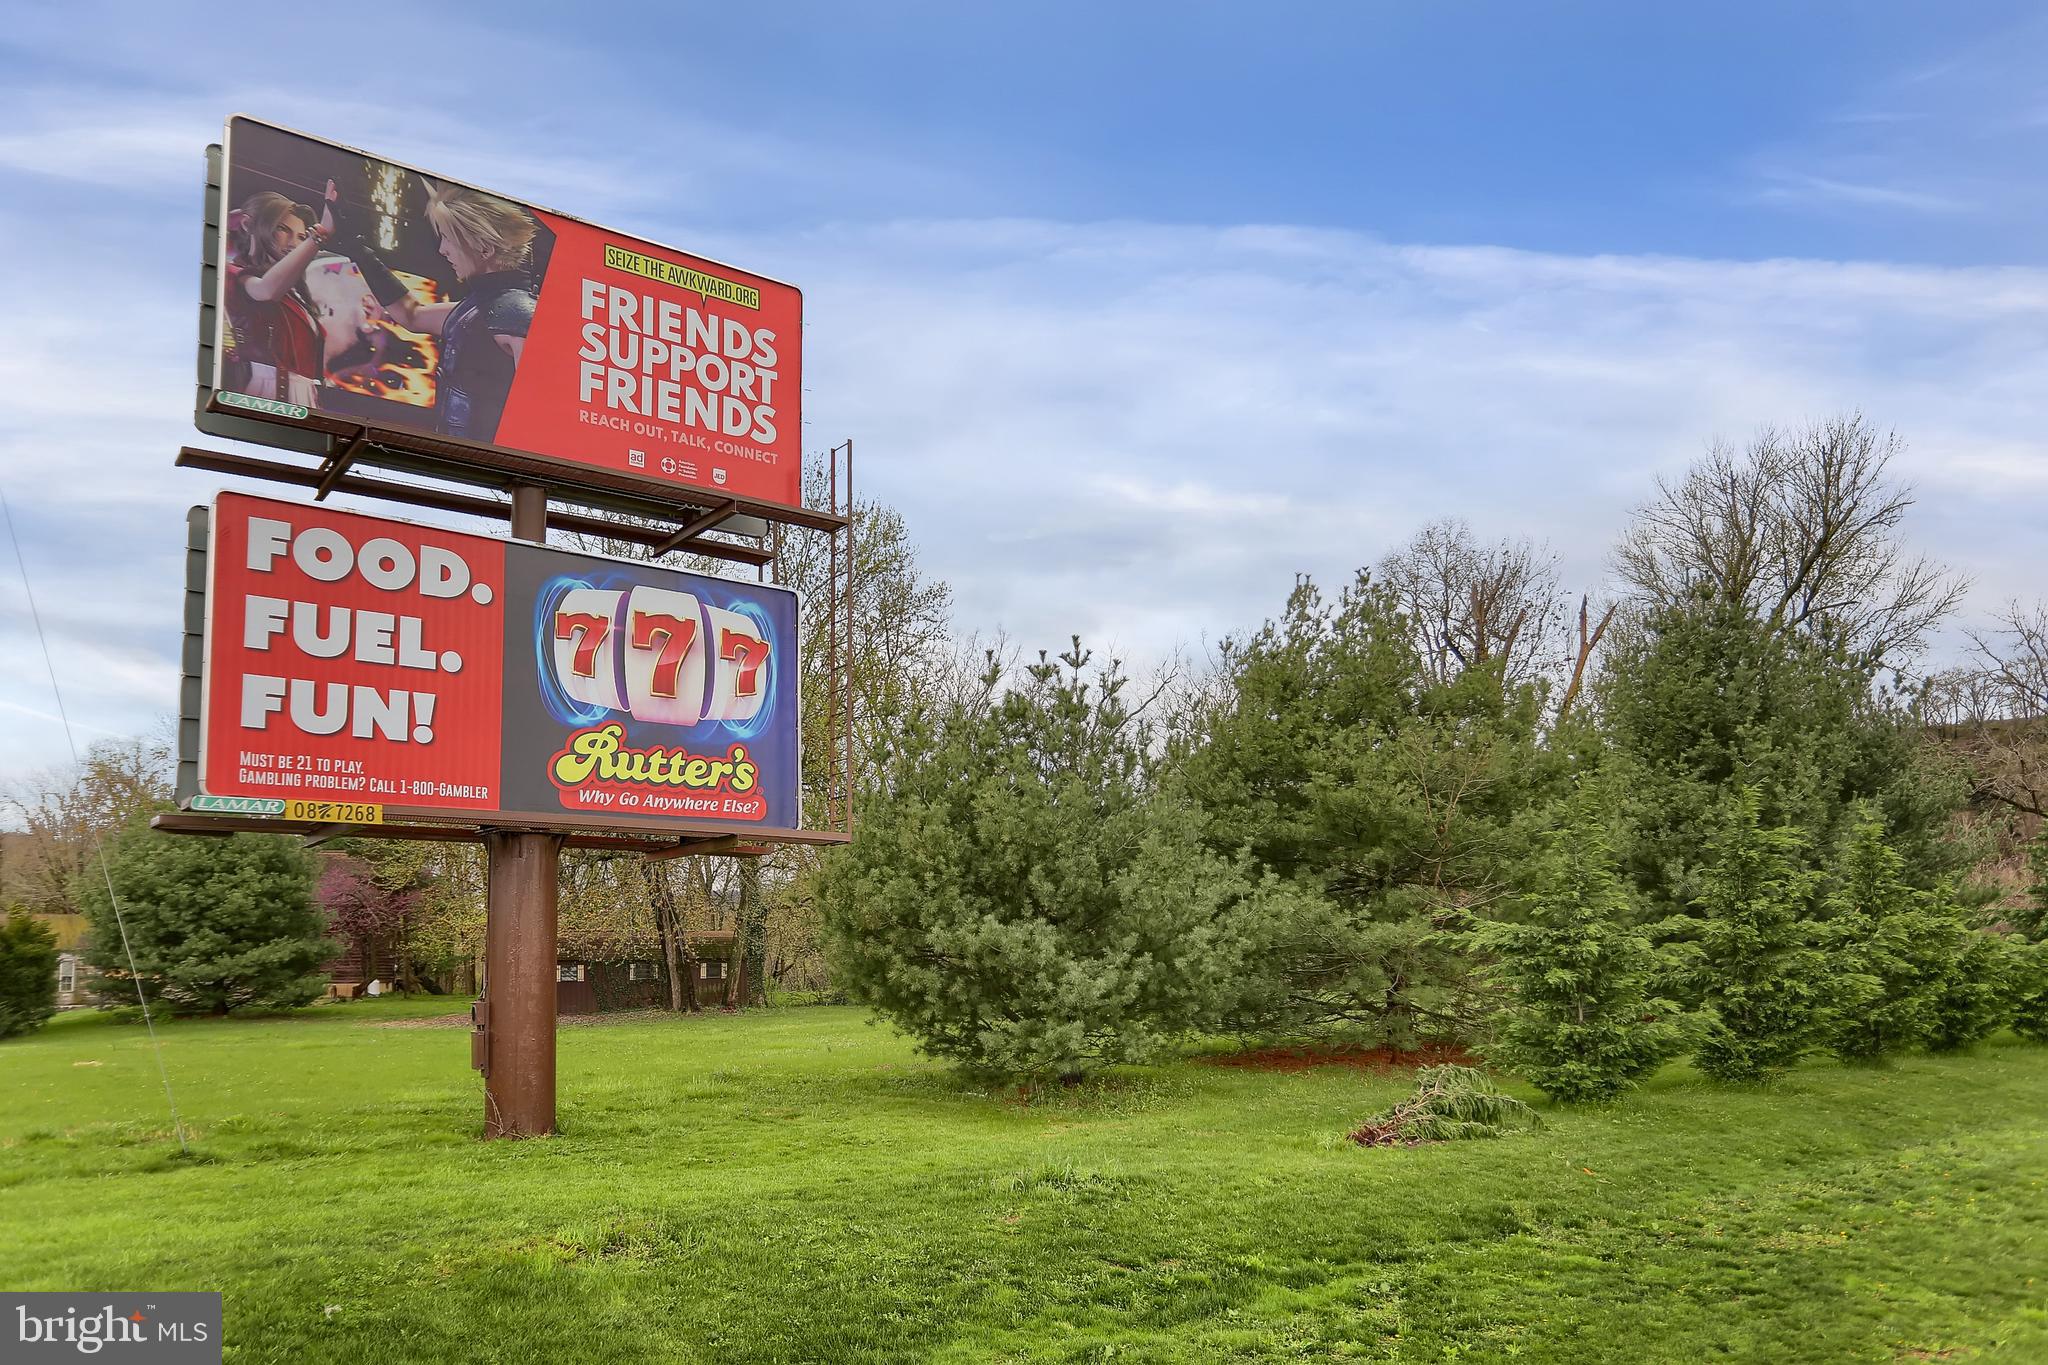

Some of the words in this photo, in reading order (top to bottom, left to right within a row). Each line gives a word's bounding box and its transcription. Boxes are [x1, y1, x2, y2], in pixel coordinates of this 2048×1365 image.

[608, 249, 640, 271] SEIZE
[643, 258, 665, 279] THE
[668, 266, 757, 307] AWKWARD.ORG
[581, 278, 778, 367] FRIENDS
[578, 323, 778, 404] SUPPORT
[223, 393, 302, 417] LAMAR
[579, 361, 778, 444] FRIENDS
[579, 410, 630, 432] REACH
[633, 422, 668, 443] OUT,
[671, 430, 711, 451] TALK,
[714, 440, 778, 465] CONNECT
[247, 516, 494, 605] FOOD.
[244, 594, 463, 673] FUEL.
[240, 673, 436, 744] FUN!
[297, 756, 312, 771] 21
[555, 723, 755, 791] Rutter's
[196, 797, 280, 813] LAMAR
[294, 801, 318, 818] 08
[336, 804, 375, 822] 7268
[578, 789, 615, 805] Why
[619, 792, 639, 806] Go
[645, 793, 719, 813] Anywhere
[722, 800, 760, 815] Else?
